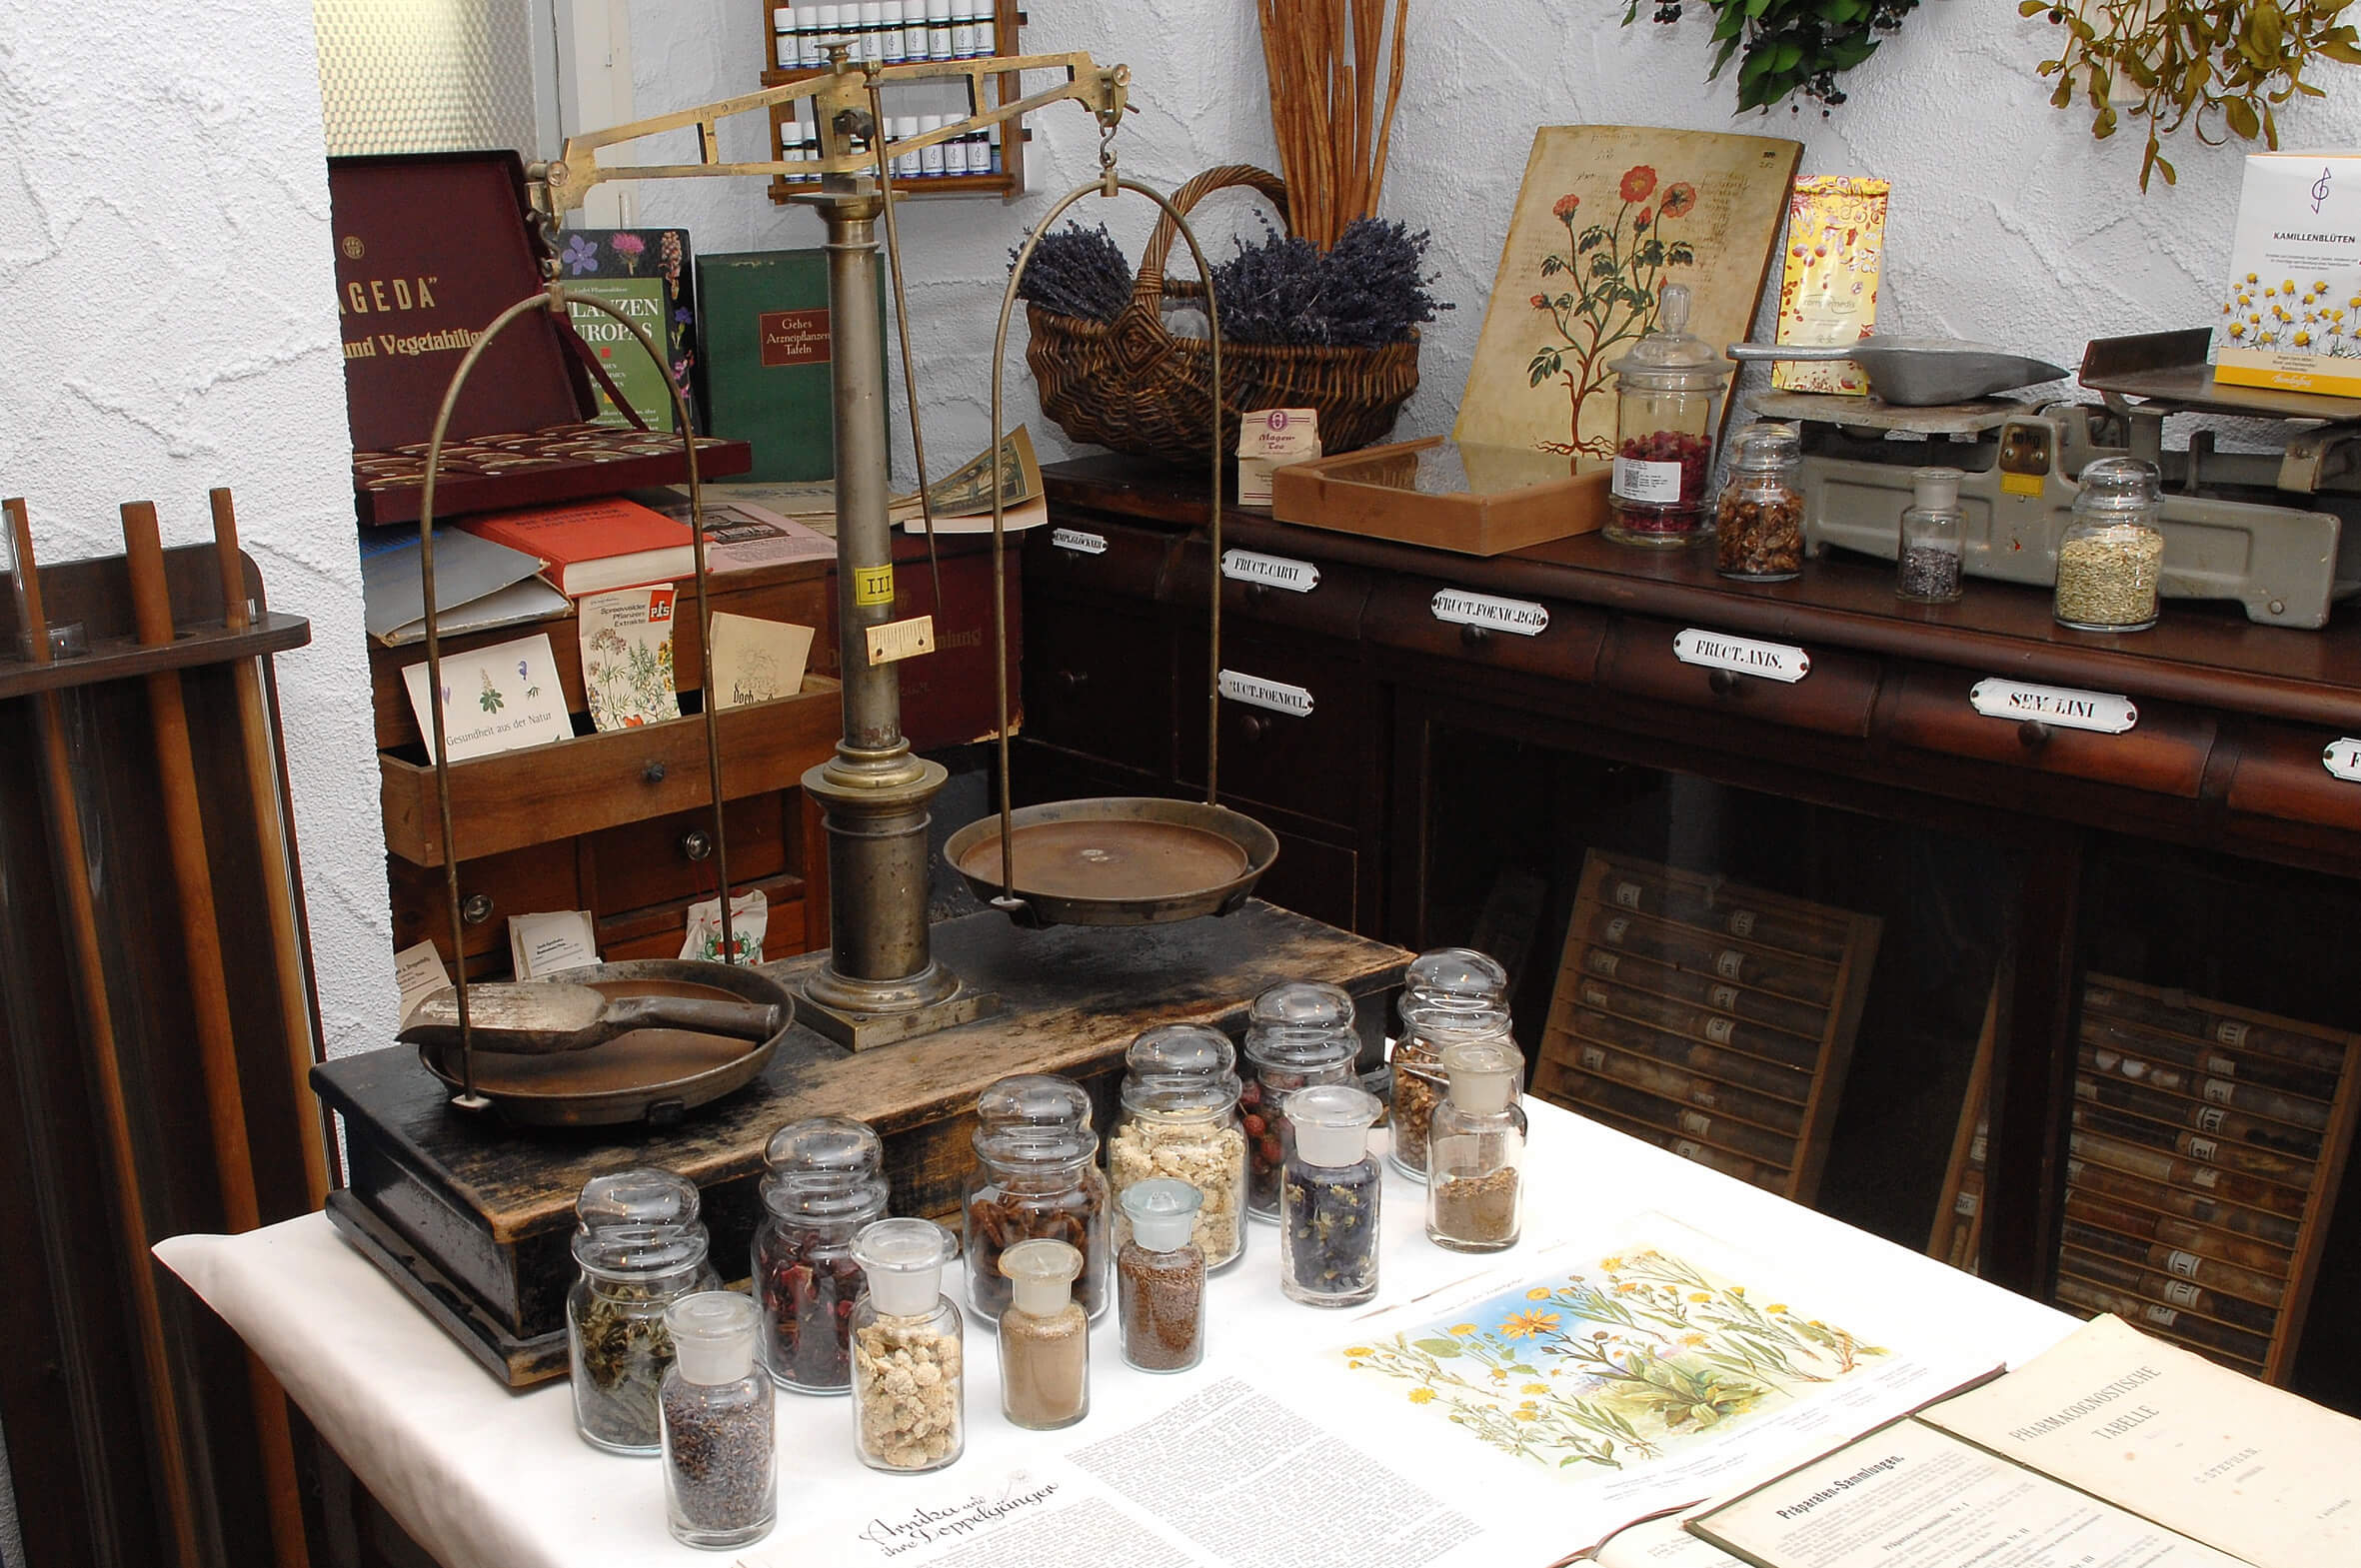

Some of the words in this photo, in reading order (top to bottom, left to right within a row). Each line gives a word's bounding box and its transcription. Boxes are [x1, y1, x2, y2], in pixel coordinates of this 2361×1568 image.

[2273, 232, 2355, 243] KAMILLENBLÜTEN
[339, 277, 438, 315] GEDA”
[784, 343, 812, 356] Tafeln
[867, 576, 892, 595] III
[446, 727, 495, 747] Gesundheit
[497, 724, 511, 734] aus
[513, 719, 526, 730] der
[528, 712, 553, 725] Natur
[2008, 1365, 2162, 1442] PHARMACOGNOSTISCHE
[2092, 1405, 2160, 1440] TABELLE
[1775, 1454, 1905, 1520] Präparaten-Sammlungen.
[859, 1507, 961, 1546] Arnika
[882, 1541, 919, 1558] ihre
[910, 1482, 1060, 1543] Doppelgänger
